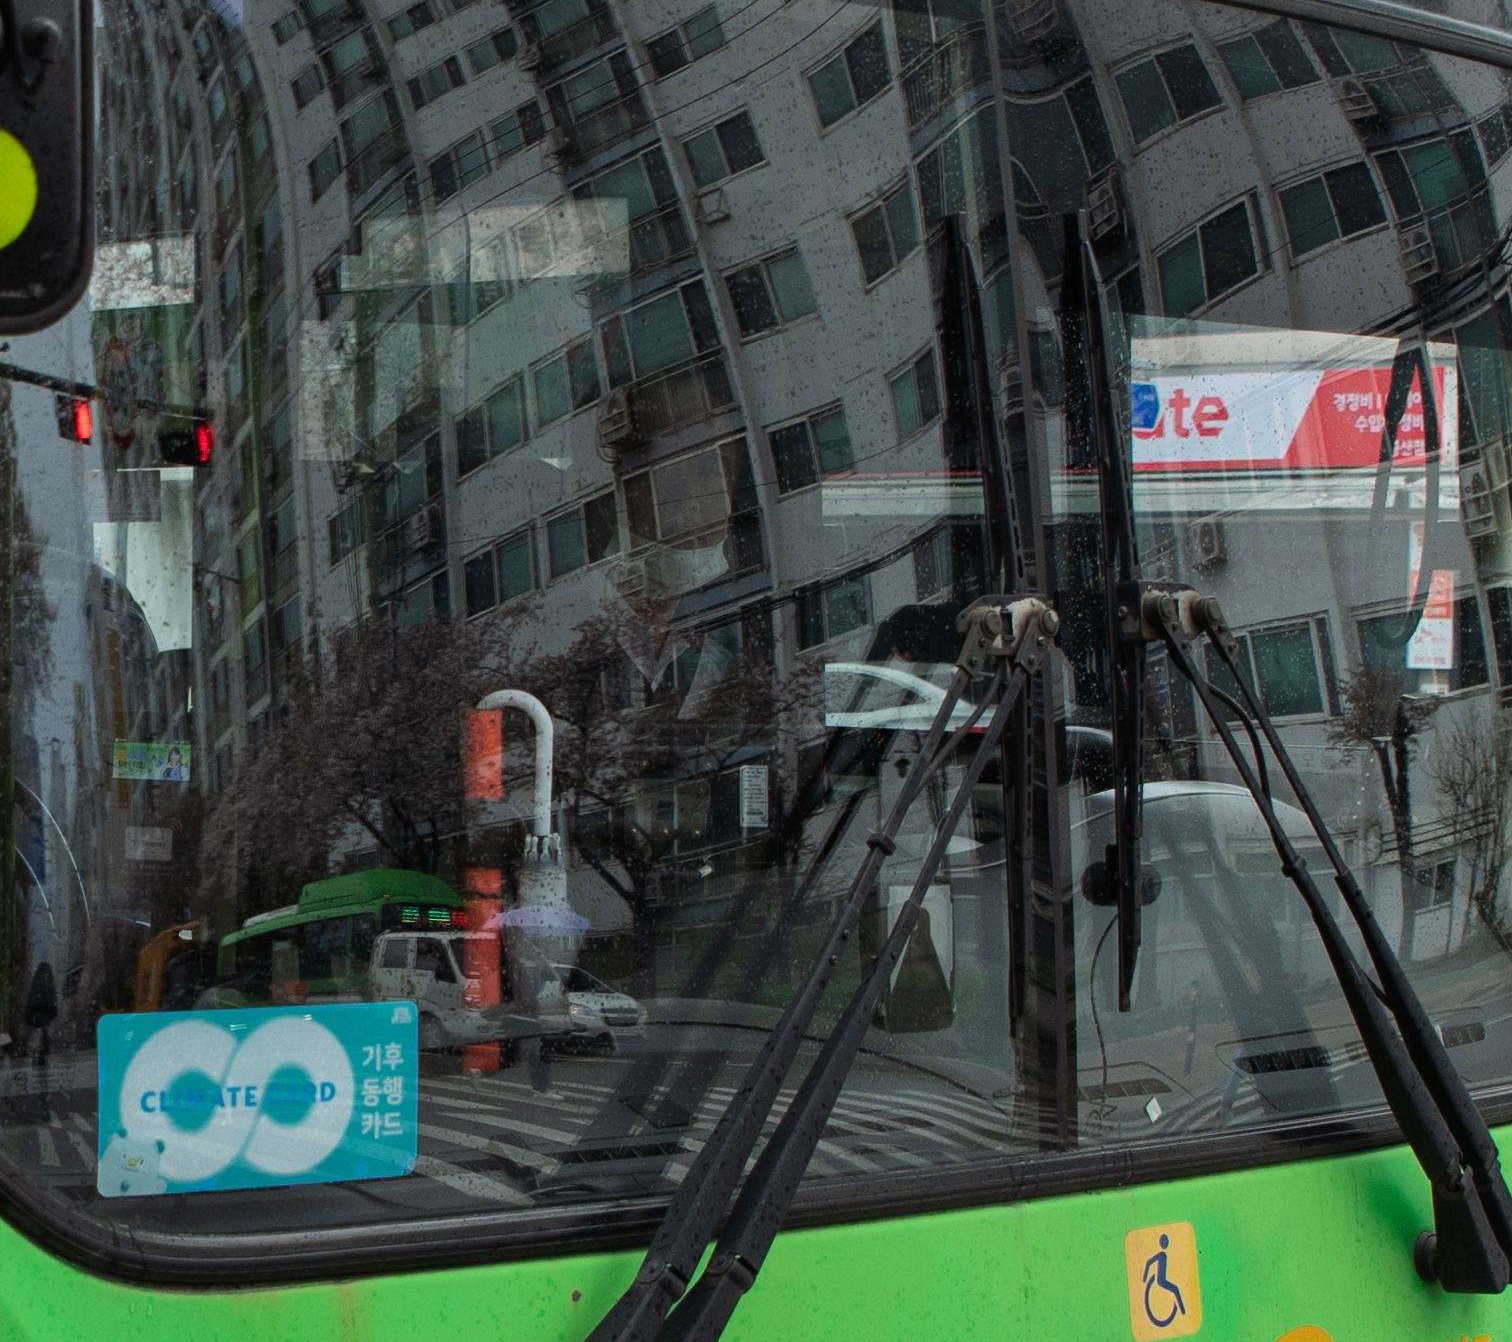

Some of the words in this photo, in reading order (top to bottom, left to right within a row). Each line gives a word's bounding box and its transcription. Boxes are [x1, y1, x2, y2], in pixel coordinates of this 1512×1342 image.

[361, 1041, 405, 1071] 기후
[139, 1085, 259, 1114] CLIMATE
[266, 1080, 337, 1106] CARD
[361, 1076, 404, 1107] 동행
[361, 1110, 405, 1140] 카드
